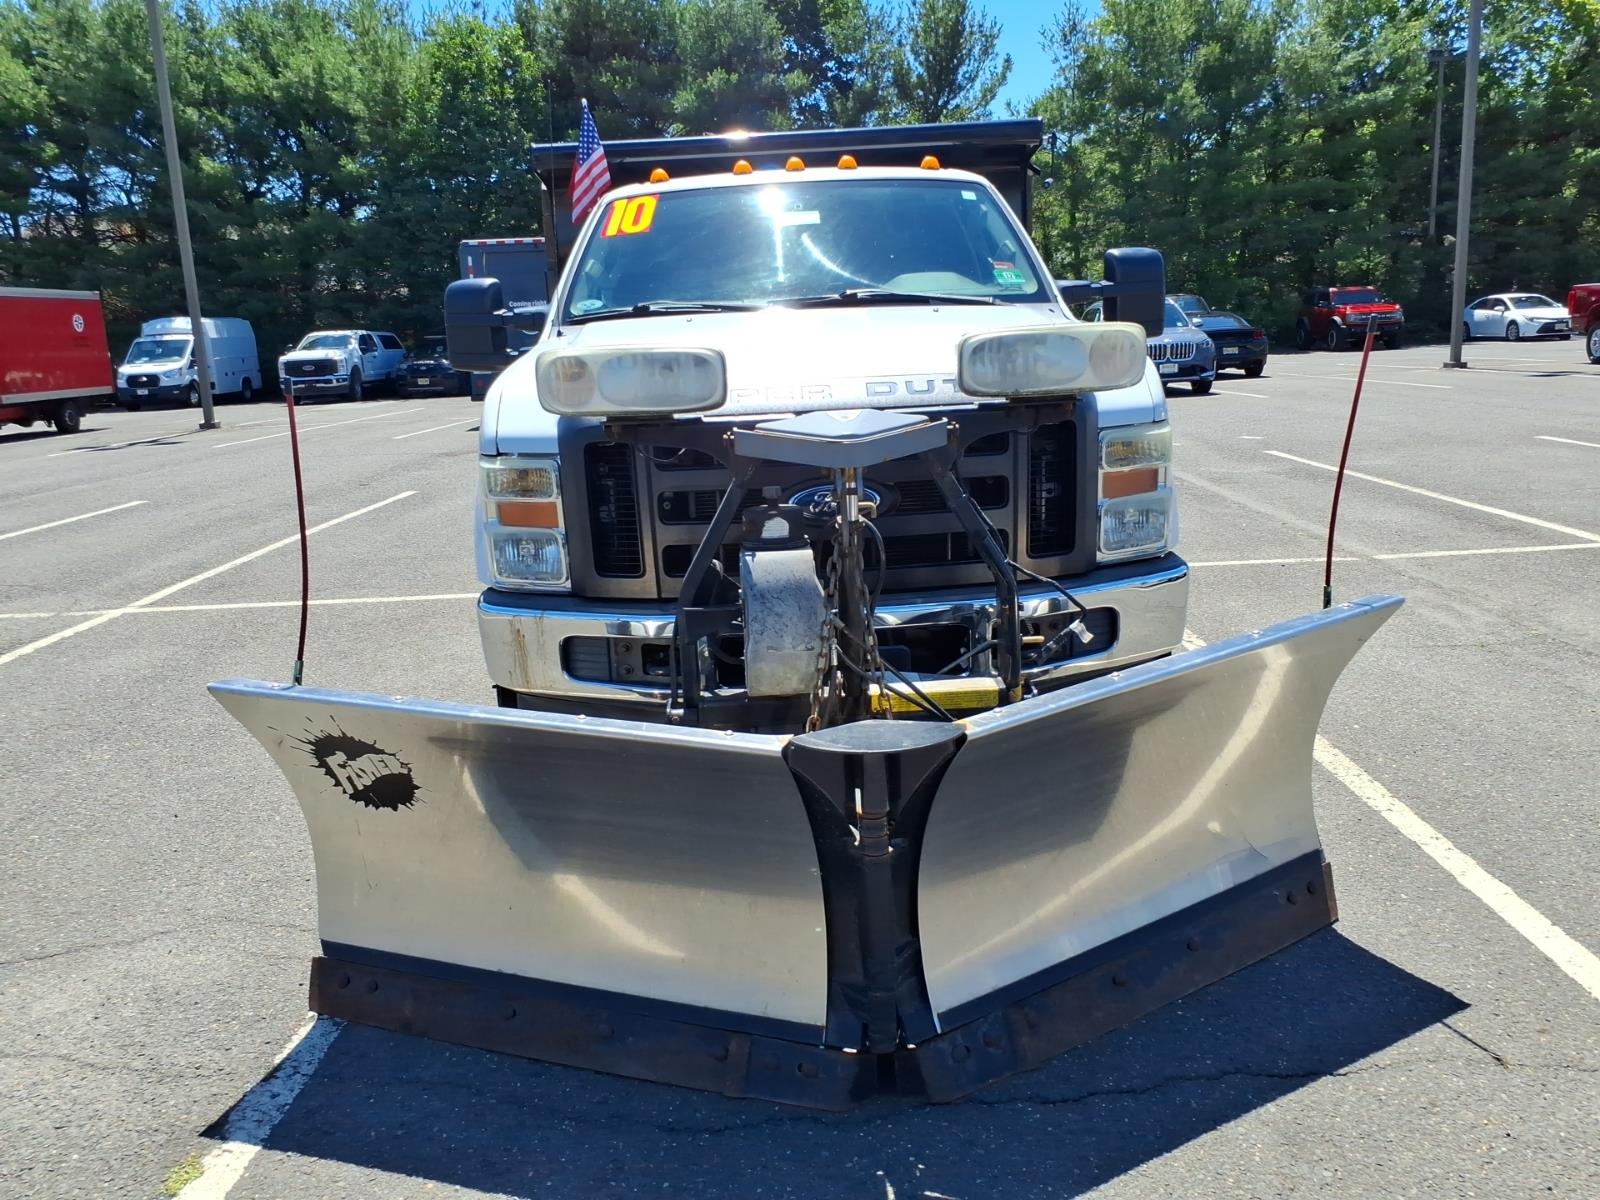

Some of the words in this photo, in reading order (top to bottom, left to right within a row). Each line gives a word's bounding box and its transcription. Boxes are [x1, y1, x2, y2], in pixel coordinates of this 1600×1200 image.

[606, 195, 656, 236] 10
[730, 385, 833, 402] PER
[865, 378, 958, 397] DUT
